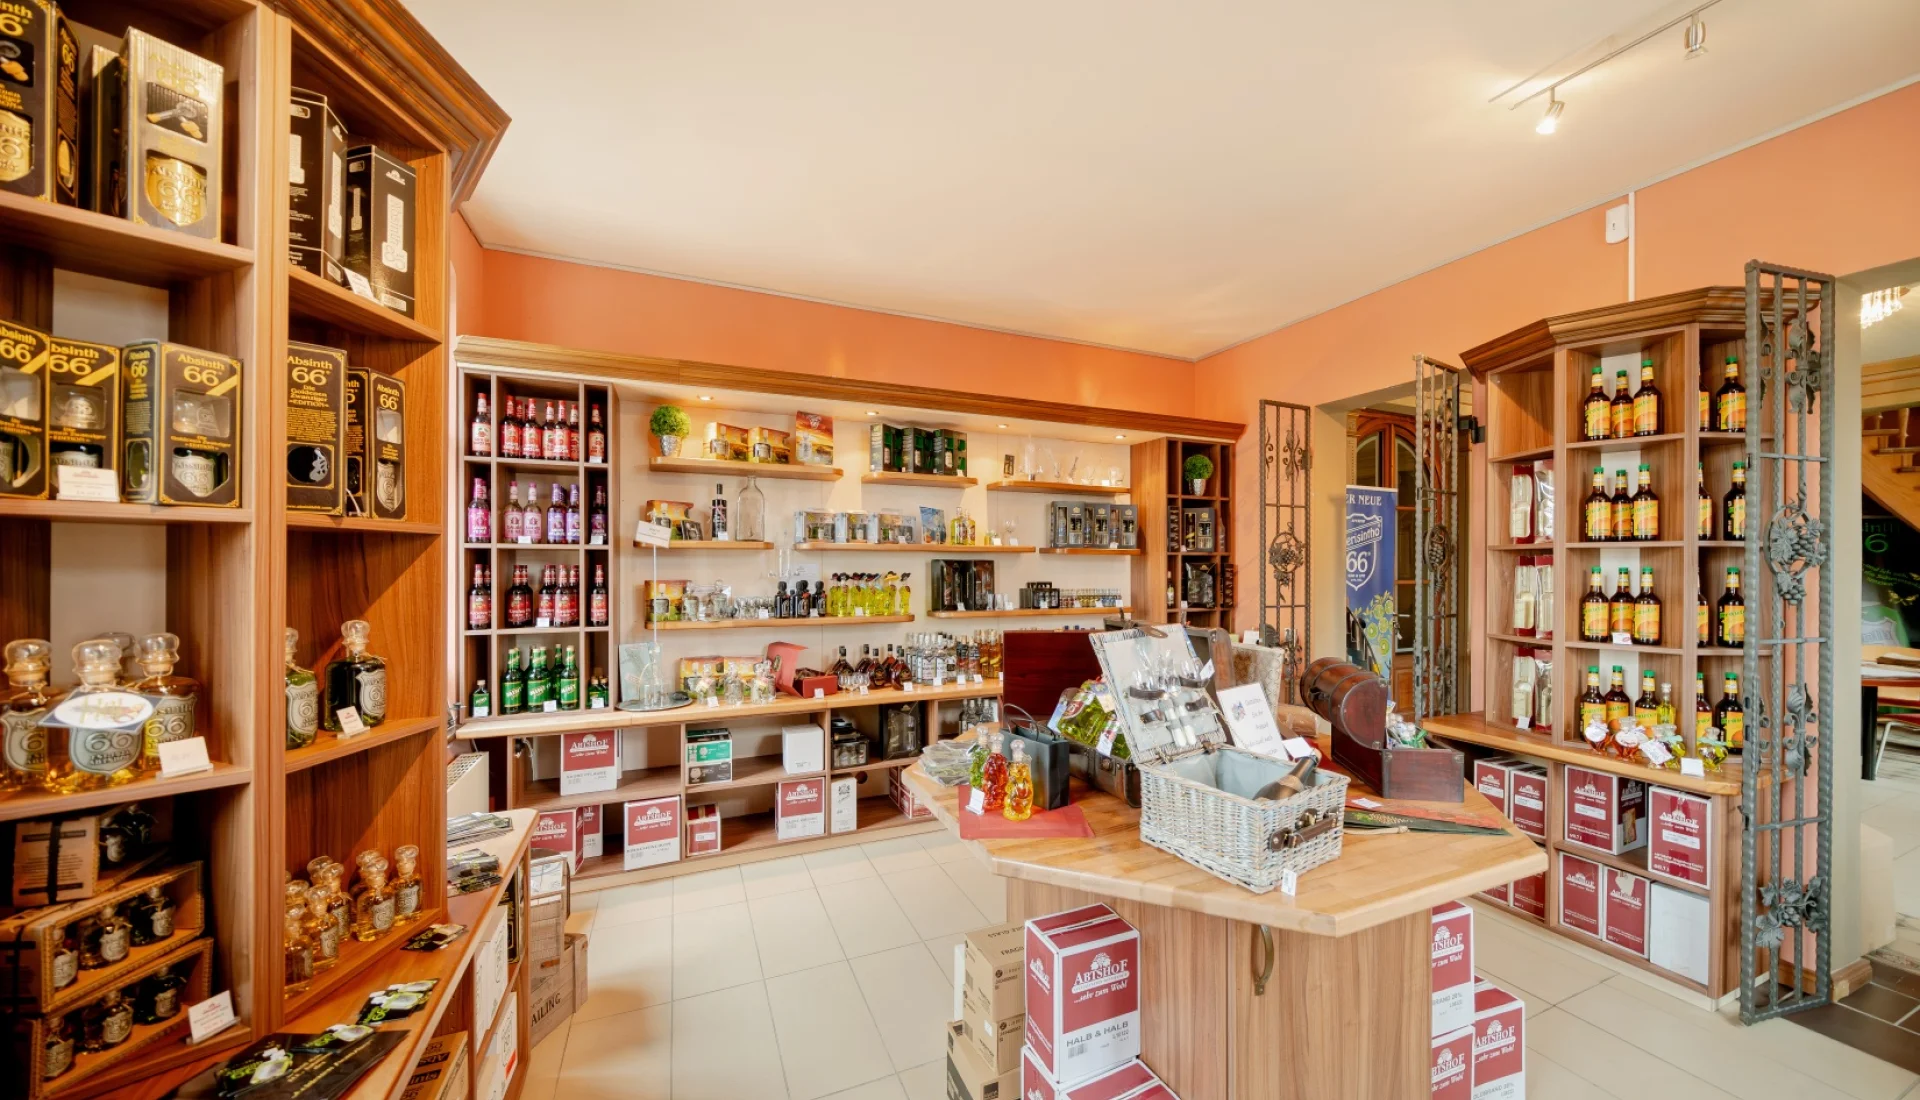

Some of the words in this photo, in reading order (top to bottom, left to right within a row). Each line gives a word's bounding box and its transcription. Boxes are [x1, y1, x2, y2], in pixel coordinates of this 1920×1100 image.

[0, 326, 37, 346] bsinth
[0, 339, 32, 364] 66
[177, 353, 226, 371] Absinth
[287, 355, 333, 370] Absinth
[50, 354, 92, 376] 66
[130, 360, 149, 378] 66
[183, 365, 220, 387] 66
[291, 366, 327, 386] 66
[380, 393, 398, 411] 66
[1358, 494, 1382, 507] NEUE
[1346, 551, 1368, 573] 66
[84, 731, 134, 753] 66
[1073, 958, 1129, 986] ABTSHOF
[531, 992, 562, 1028] AILING
[1066, 1032, 1093, 1048] HALB
[1094, 1030, 1102, 1038] &
[1103, 1020, 1129, 1035] HALB
[1476, 1025, 1515, 1049] ABTSHOF
